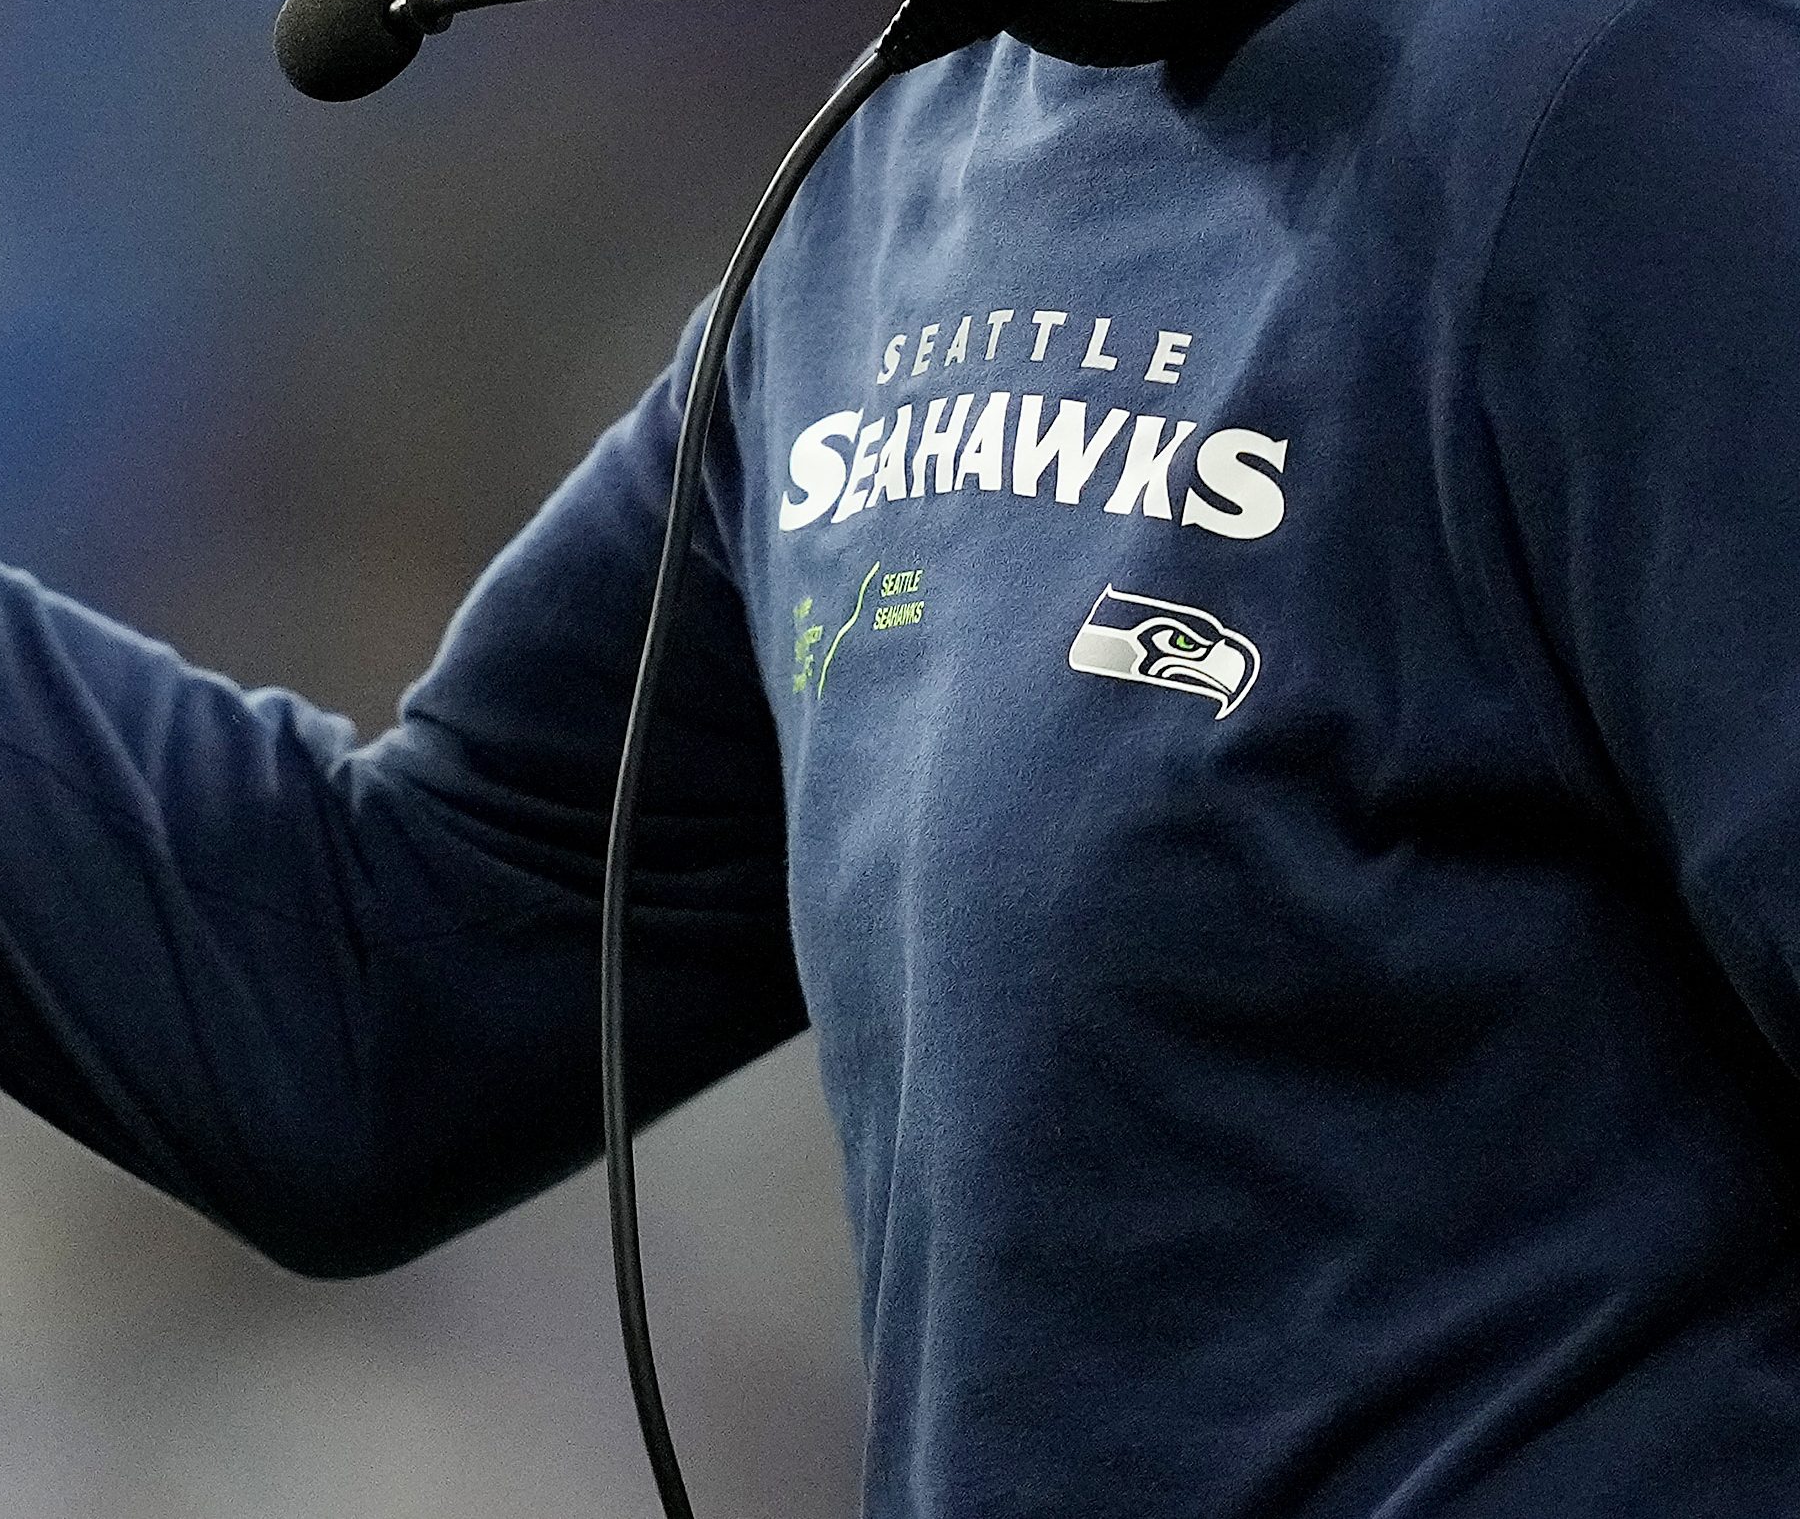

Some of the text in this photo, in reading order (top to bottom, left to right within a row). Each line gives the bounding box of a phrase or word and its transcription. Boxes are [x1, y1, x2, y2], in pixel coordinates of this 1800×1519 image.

[877, 309, 1193, 385] SEATTLE
[779, 390, 1289, 540] SEAHAWKS
[880, 569, 924, 598] SEATTLE
[872, 600, 925, 631] SEAHAWKS
